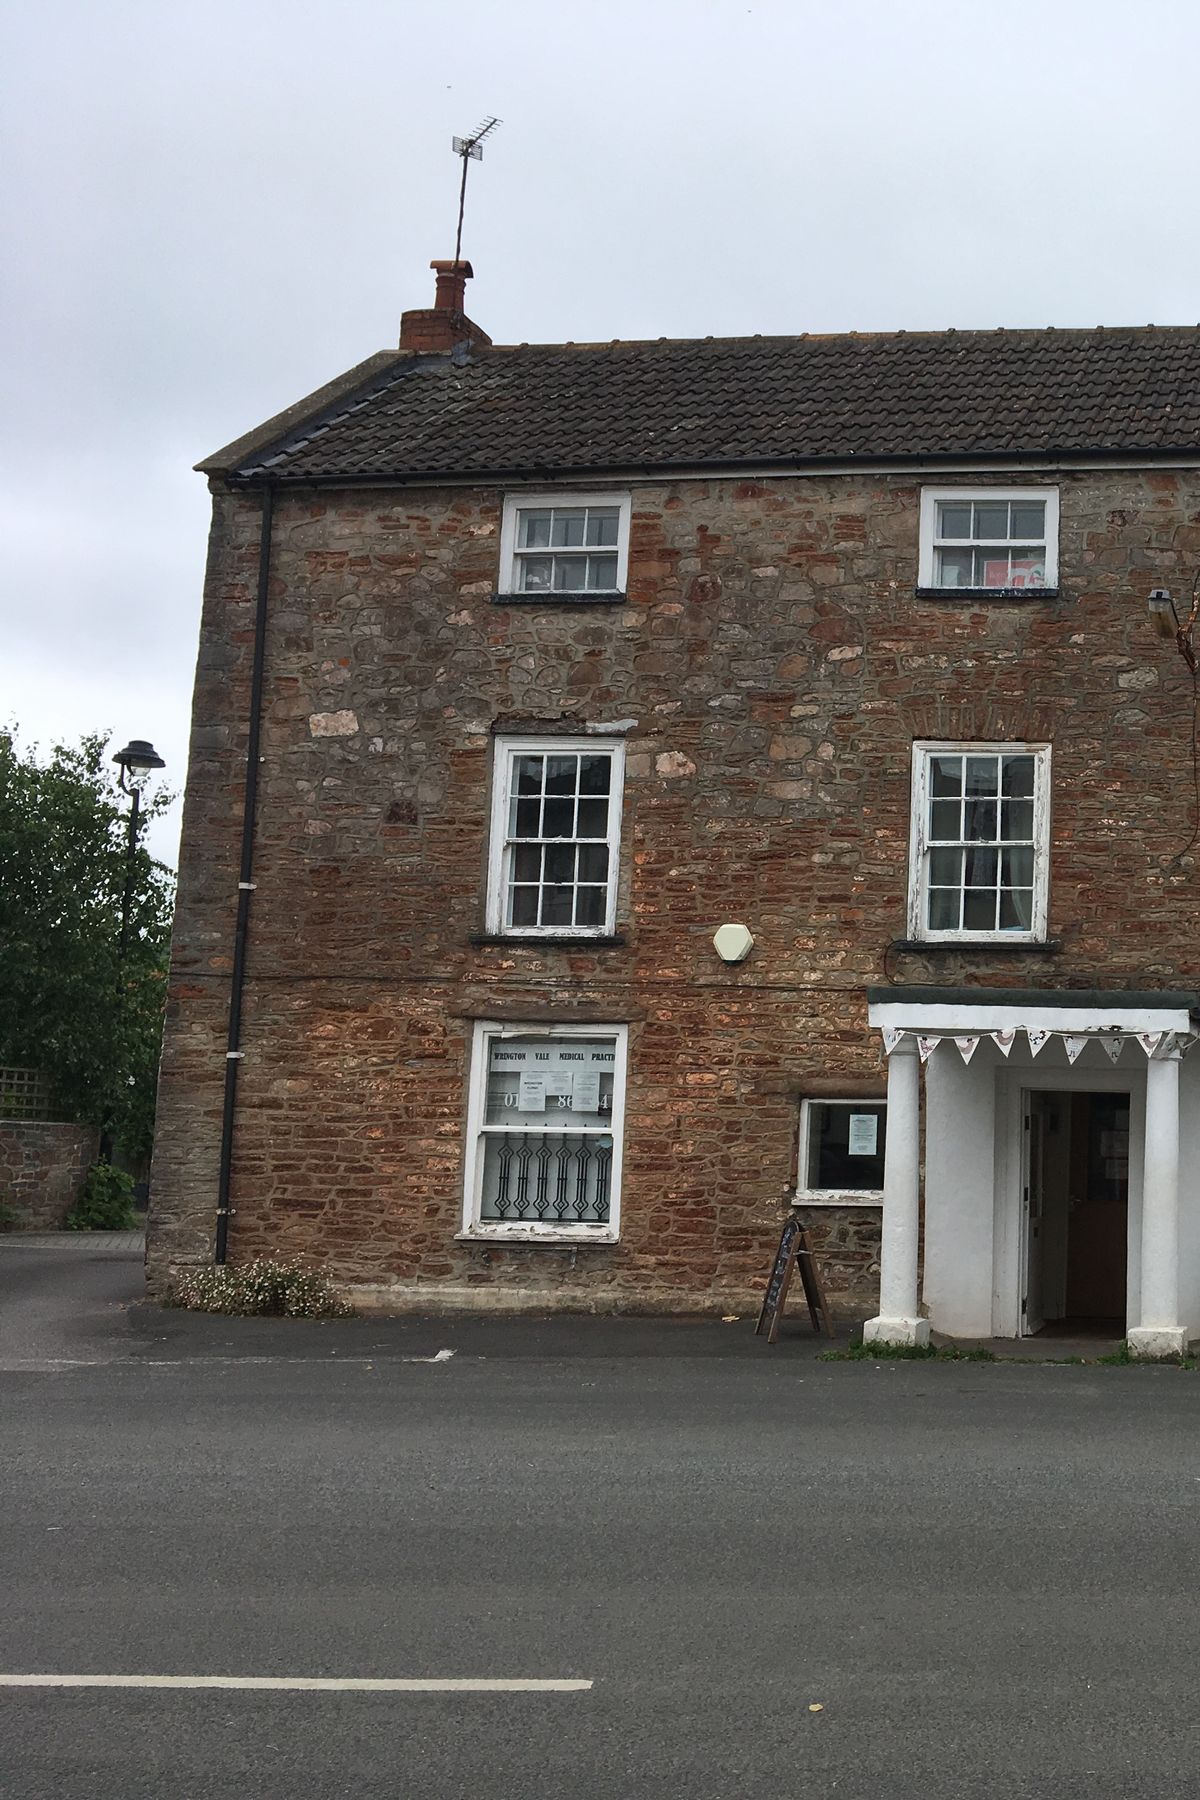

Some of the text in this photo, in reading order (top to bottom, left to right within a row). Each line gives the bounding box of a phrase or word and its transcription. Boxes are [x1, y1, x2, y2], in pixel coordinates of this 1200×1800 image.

[494, 1052, 526, 1061] WRINGTON
[535, 1052, 550, 1061] VALE
[560, 1052, 585, 1061] MEDICAL
